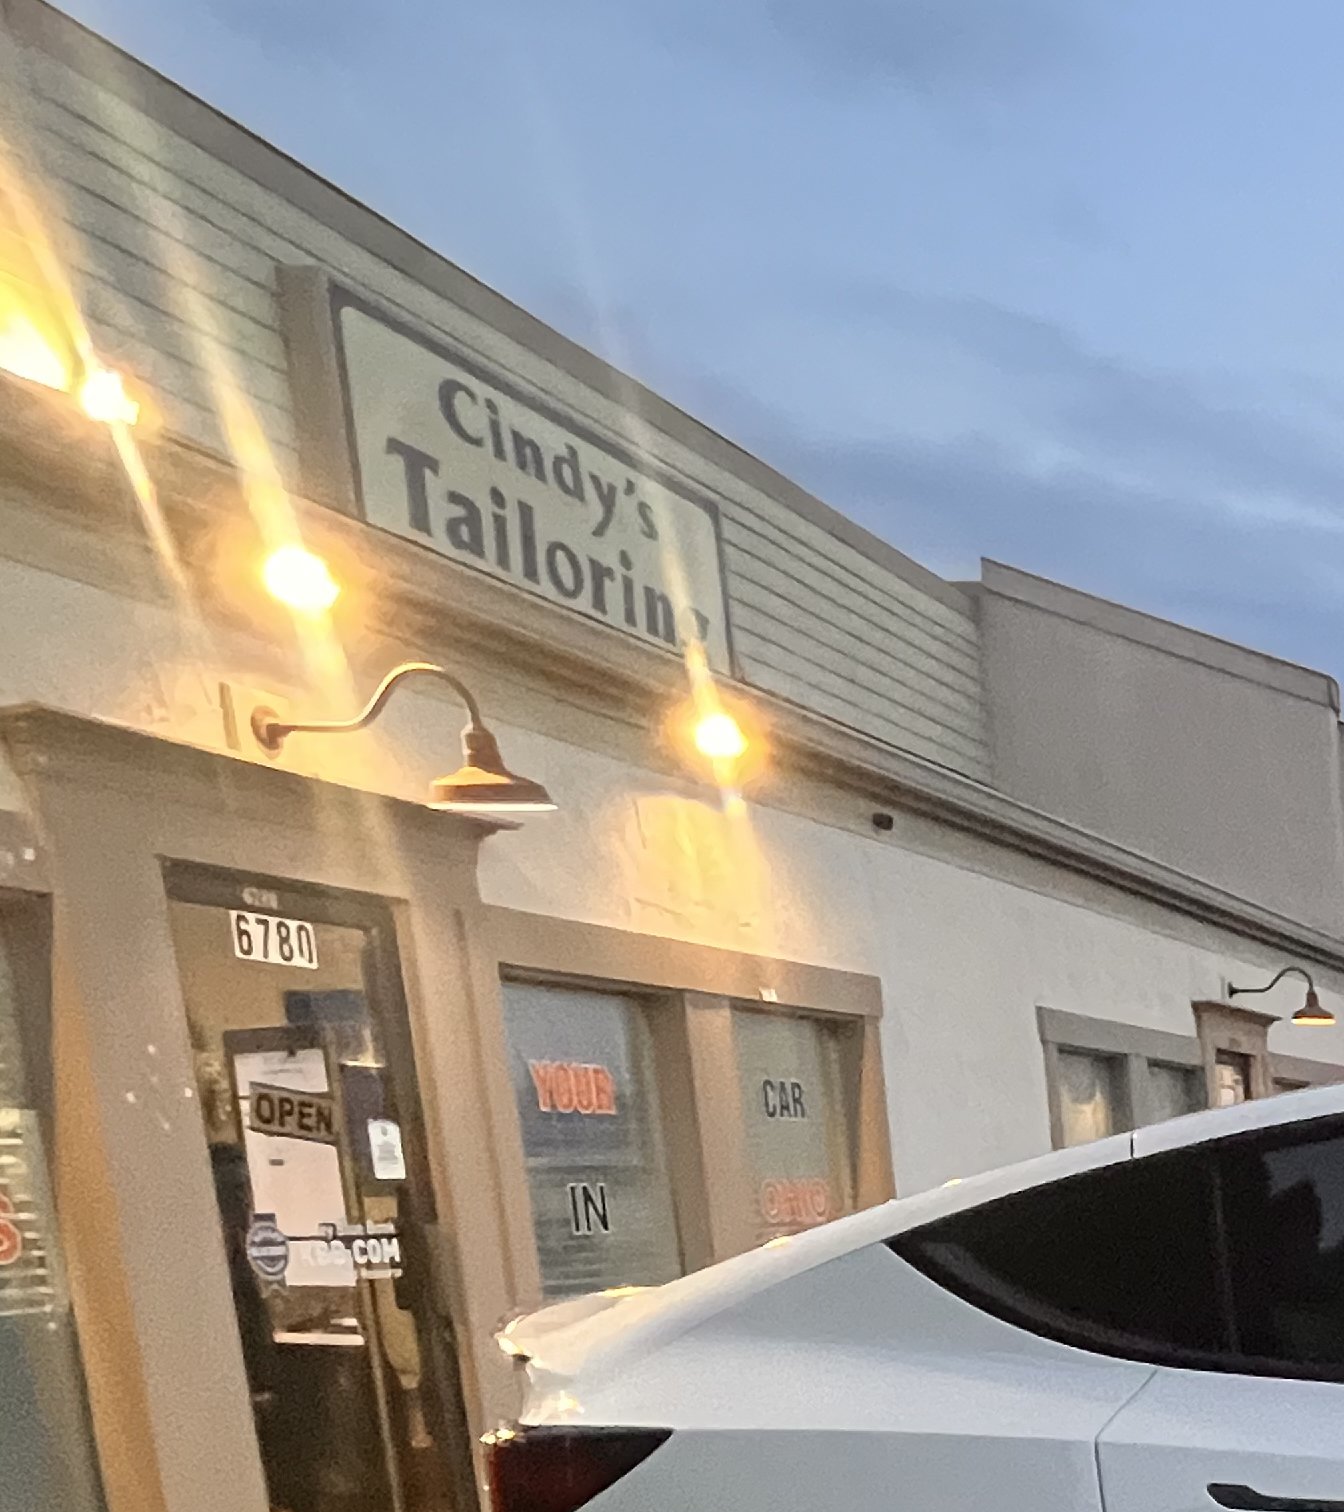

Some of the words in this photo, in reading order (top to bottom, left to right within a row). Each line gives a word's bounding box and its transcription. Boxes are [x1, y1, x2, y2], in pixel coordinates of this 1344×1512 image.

[437, 377, 658, 542] Cindy's
[384, 435, 710, 648] Tailorin
[235, 913, 315, 965] 6780
[254, 1092, 333, 1135] OPEN
[528, 1058, 617, 1116] YOUR
[761, 1078, 807, 1120] CAR
[567, 1182, 611, 1235] IN
